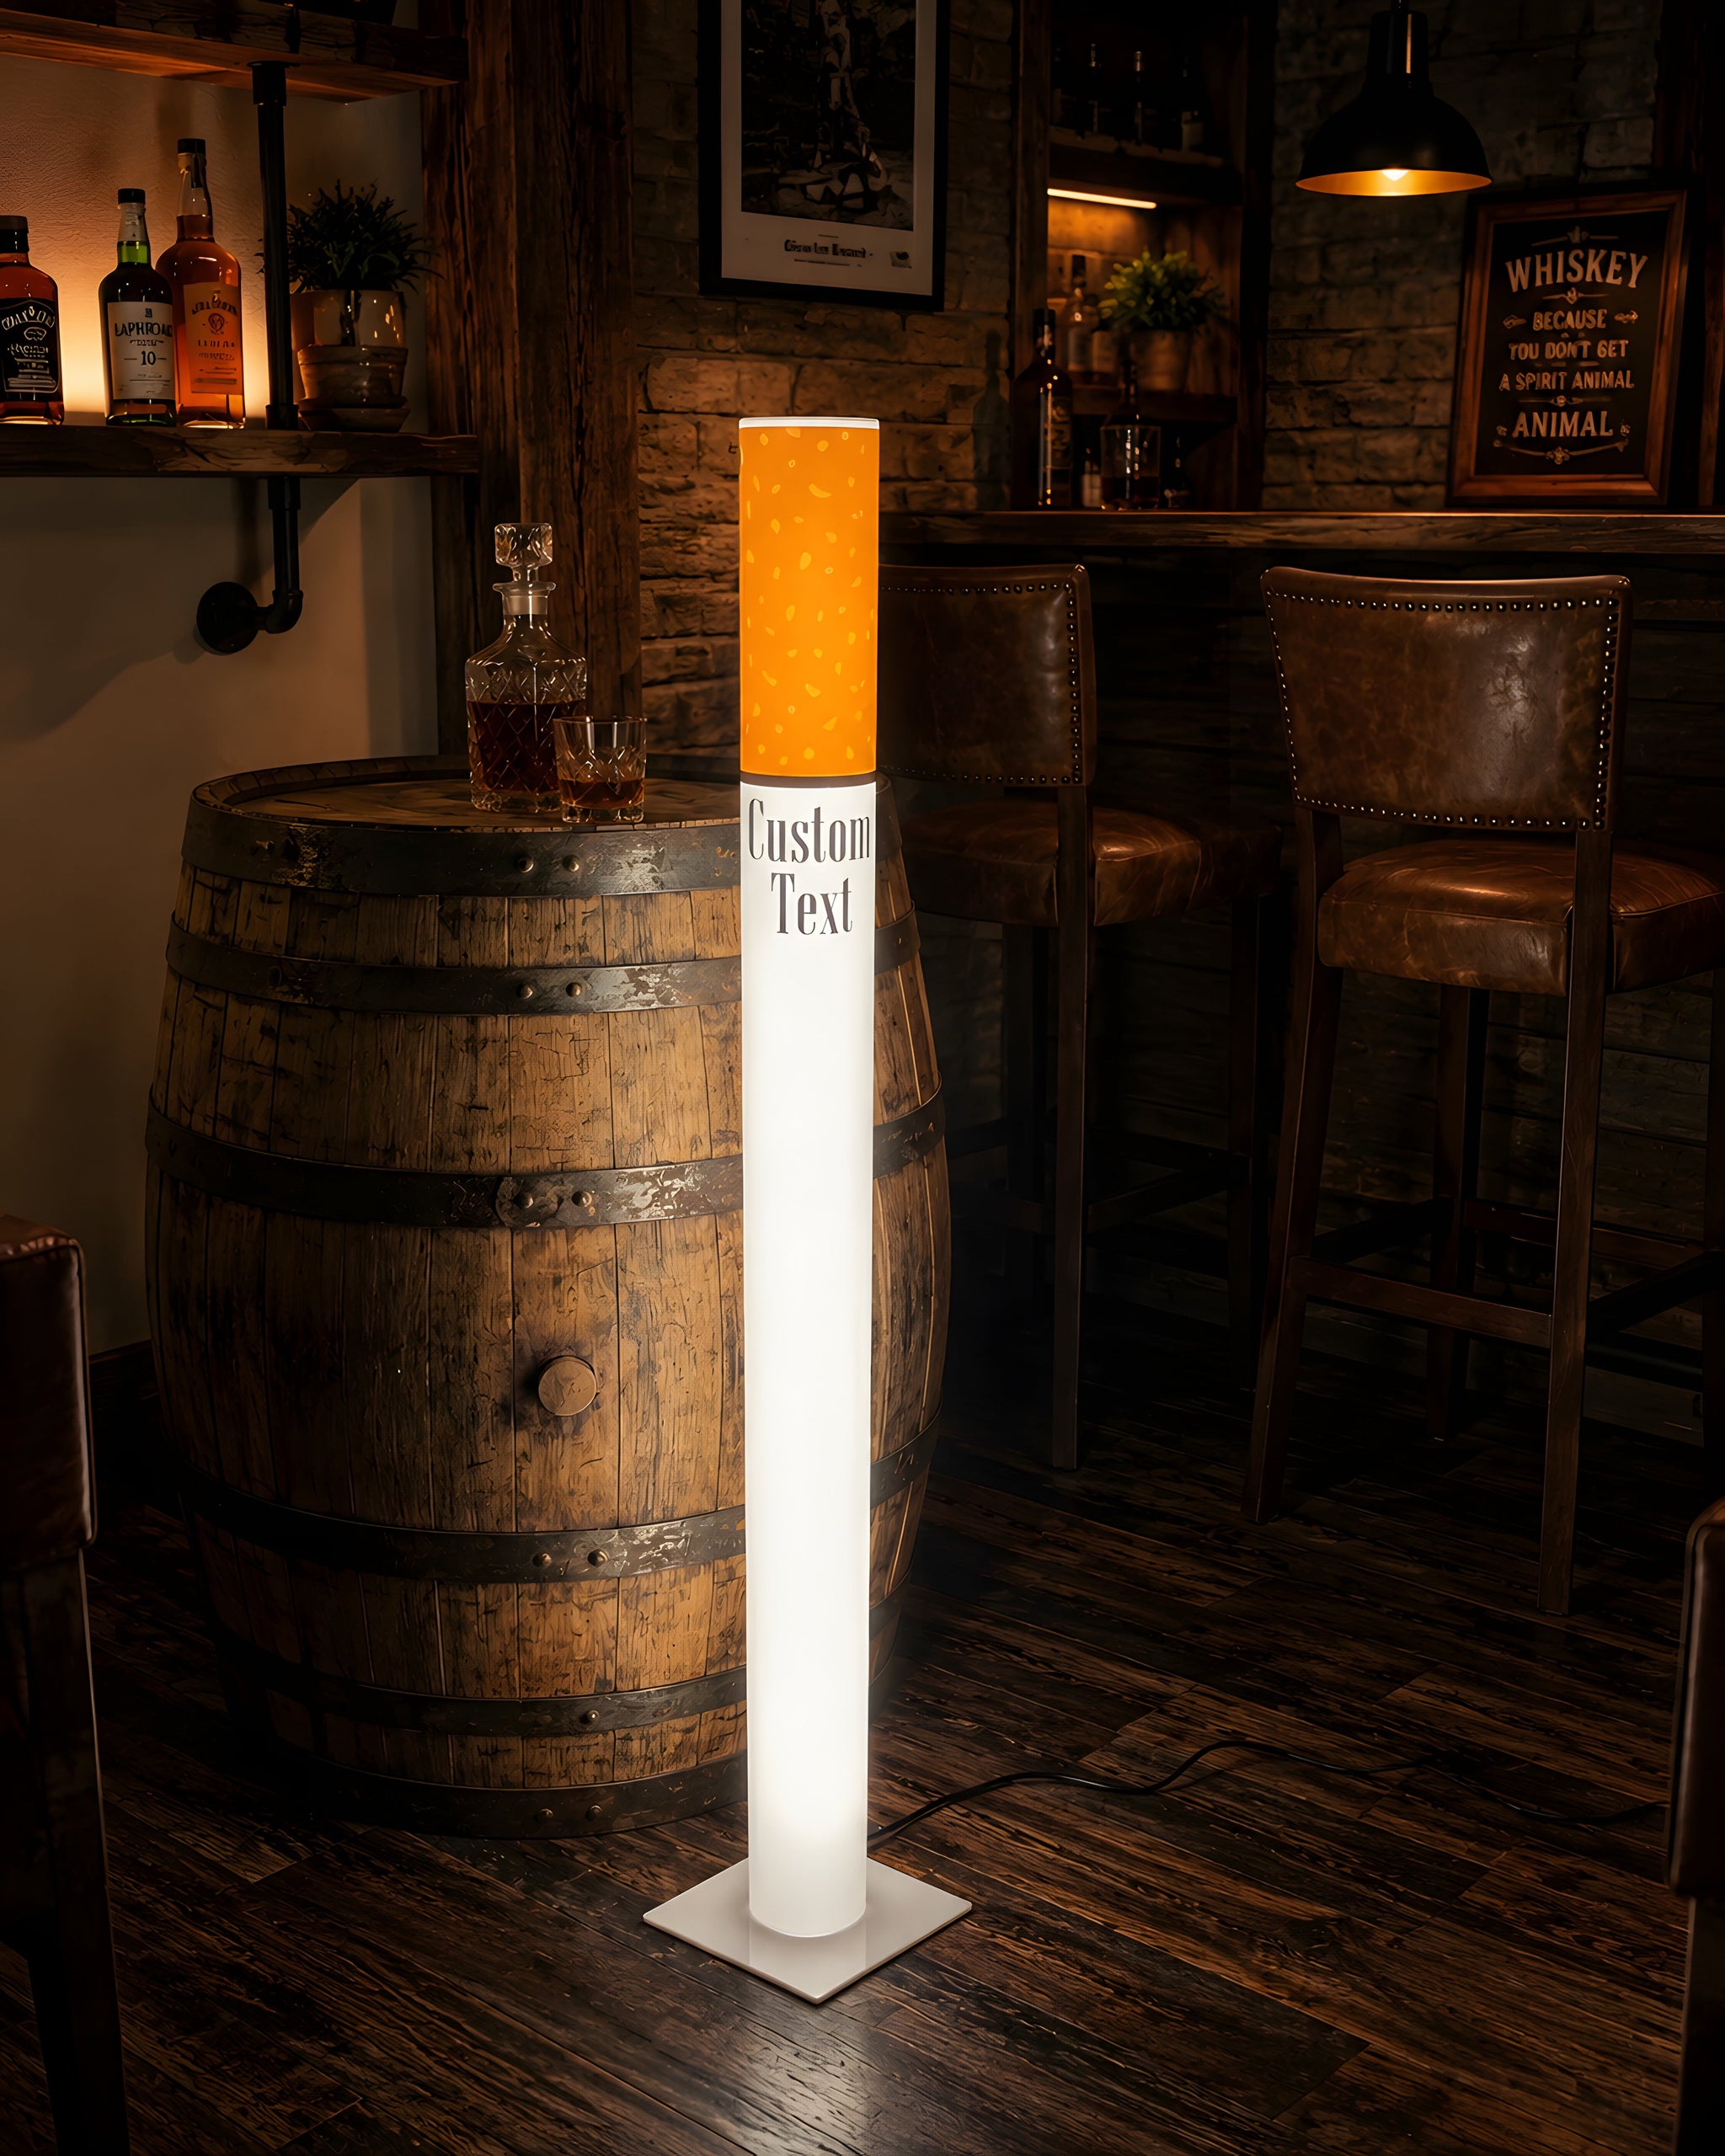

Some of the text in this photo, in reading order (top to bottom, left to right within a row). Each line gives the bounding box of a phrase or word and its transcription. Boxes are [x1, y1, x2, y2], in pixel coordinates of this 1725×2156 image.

[1505, 248, 1648, 292] WHISKEY
[1532, 308, 1607, 331] BECAUSE
[141, 350, 157, 366] 10
[1498, 370, 1635, 391] A SPIRIT ANIMAL
[1511, 410, 1614, 439] ANIMAL
[748, 798, 870, 863] Custom
[771, 872, 853, 936] Text
